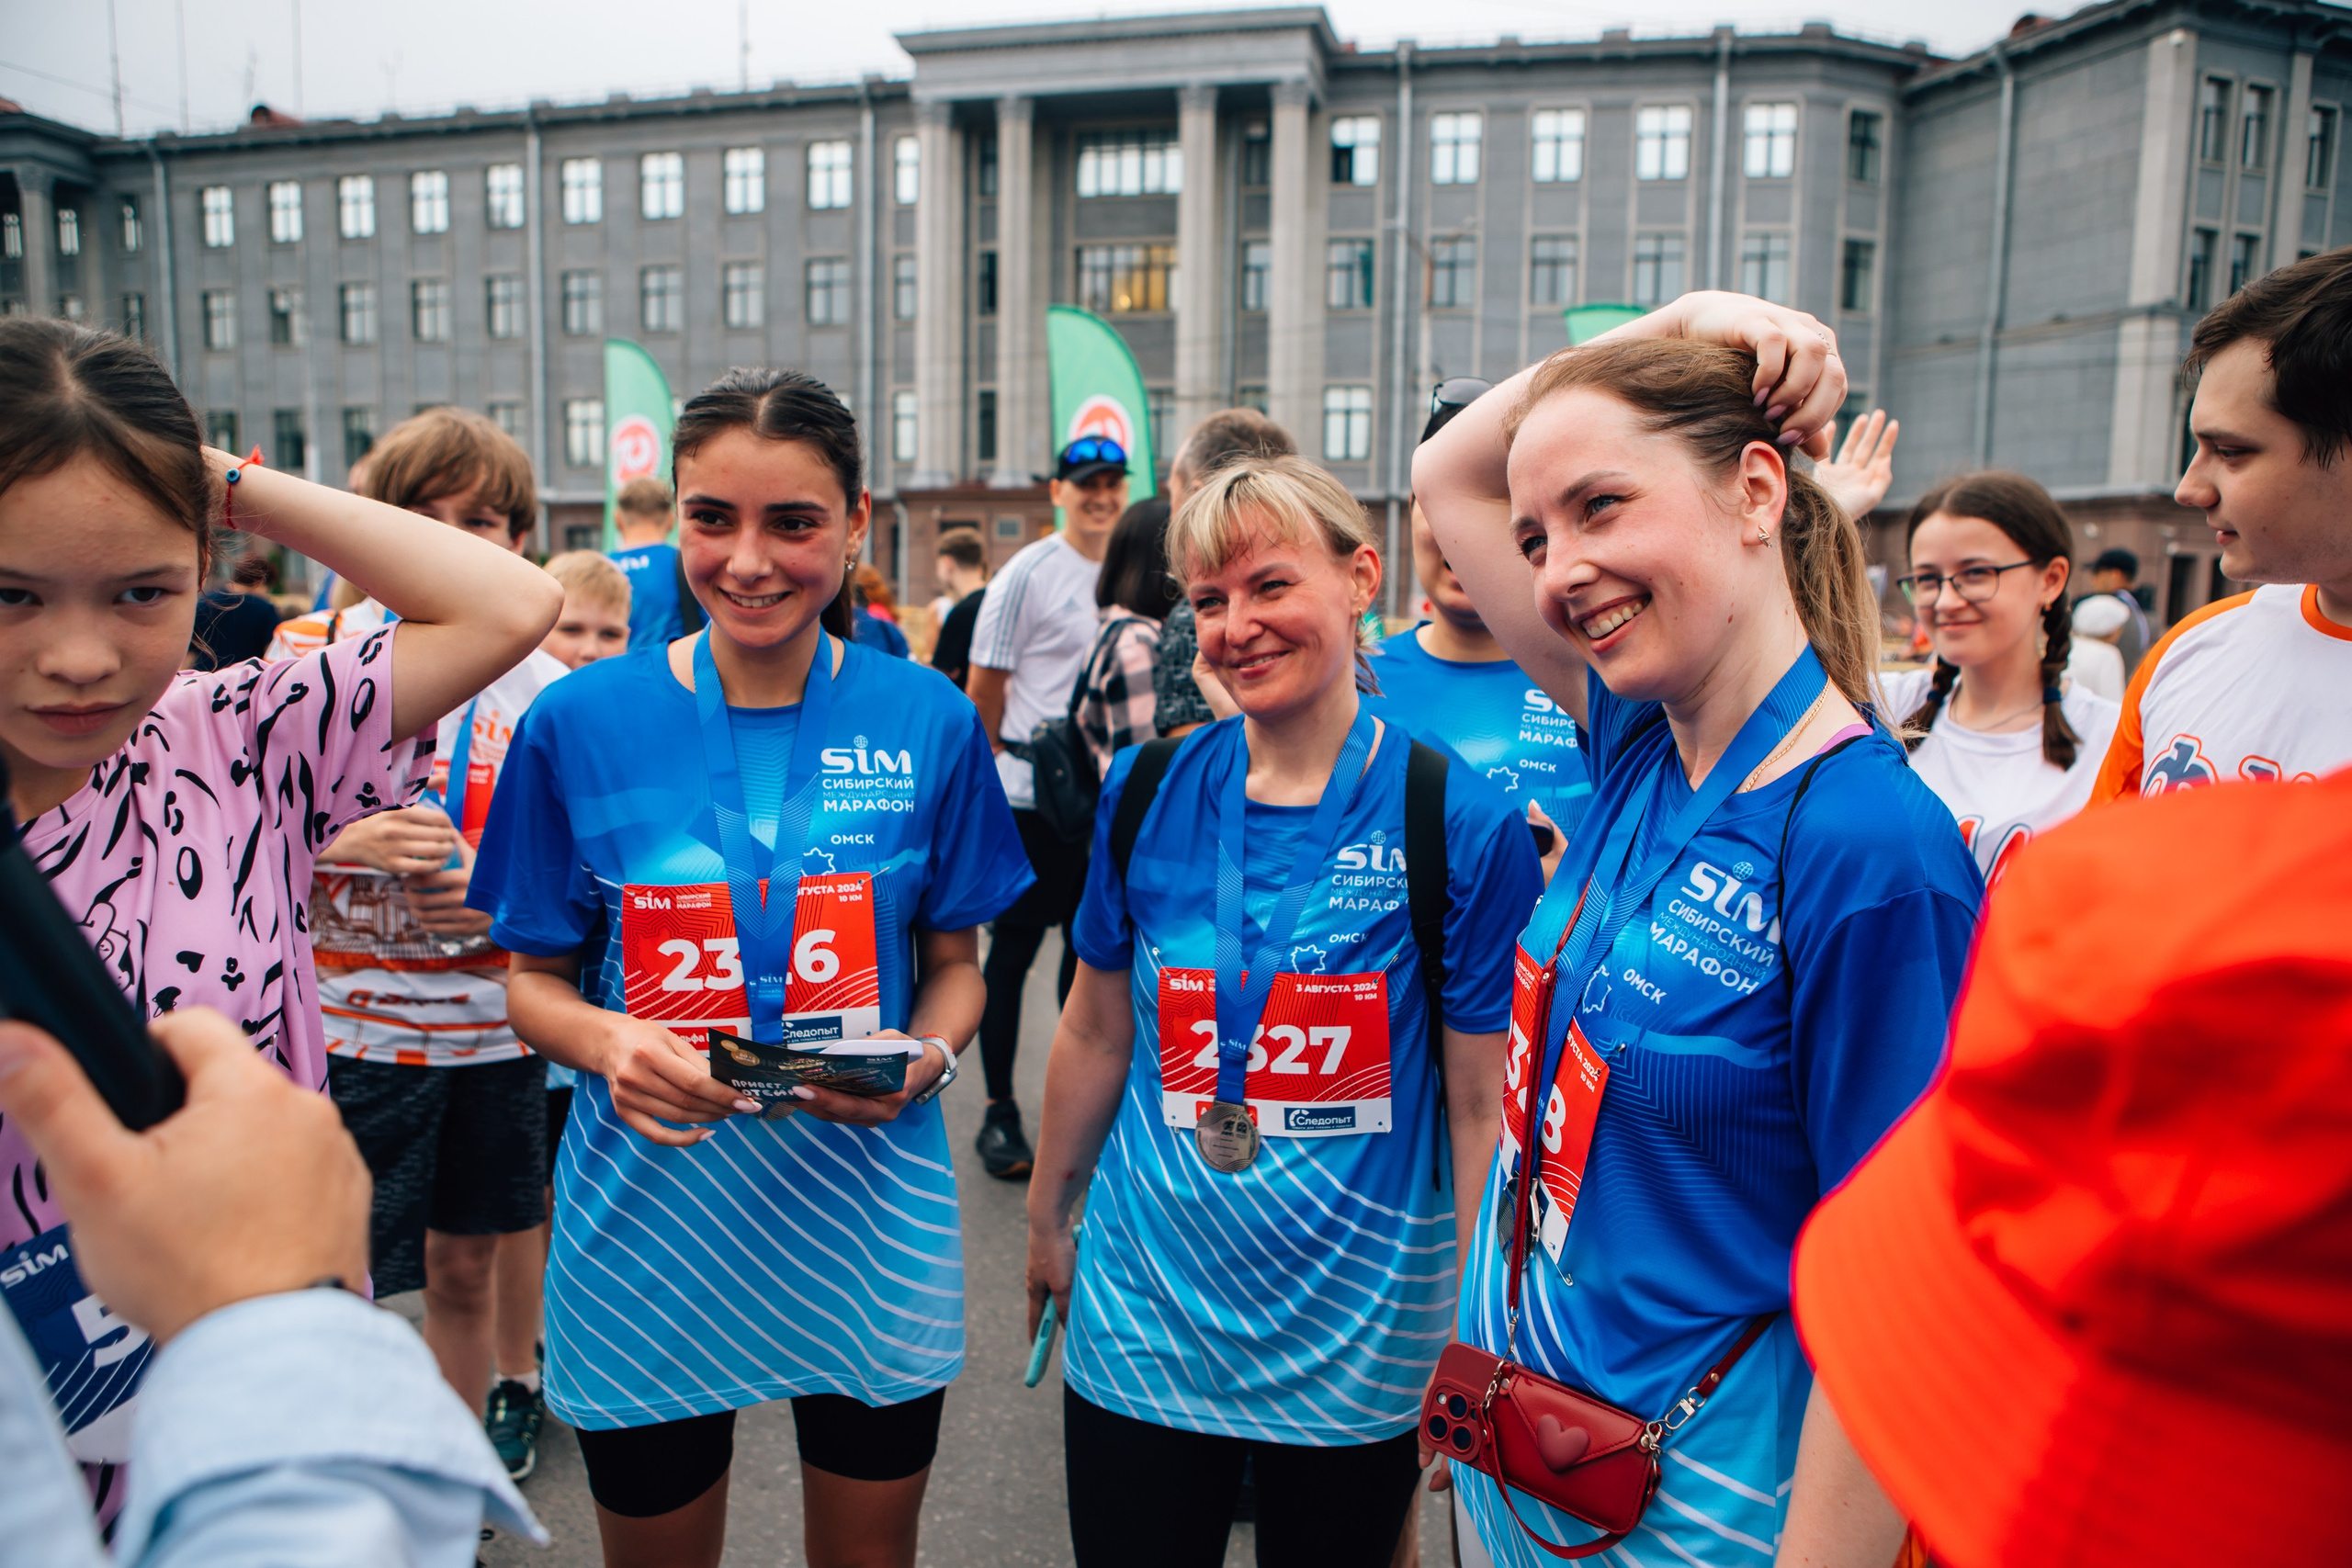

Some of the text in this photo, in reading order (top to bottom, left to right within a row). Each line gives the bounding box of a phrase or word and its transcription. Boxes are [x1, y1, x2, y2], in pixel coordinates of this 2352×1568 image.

[1521, 713, 1576, 729] СИБИРС
[1519, 729, 1578, 749] МАРАФ
[1519, 759, 1557, 773] ОМСК
[822, 776, 914, 790] СИБИРСКИЙ
[823, 798, 914, 813] МАРАФОН
[831, 834, 875, 845] ОМСК
[836, 883, 863, 894] 2024
[1332, 874, 1409, 889] СИБИРСК
[1329, 897, 1409, 912] МАРАФ
[1329, 932, 1370, 944] ОМСК
[1668, 898, 1775, 968] СИБИРСКИЙ
[1657, 911, 1767, 980] МЕЖДУНАРОДНЫЙ
[657, 929, 840, 992] 236
[1650, 921, 1759, 995] МАРАФОН
[1295, 982, 1378, 994] 3 АВГУСТА 2024
[1623, 968, 1668, 1005] ОМСК
[1354, 994, 1365, 1002] 10
[782, 1026, 839, 1040] Следопыт
[1295, 1116, 1352, 1126] Следопыт
